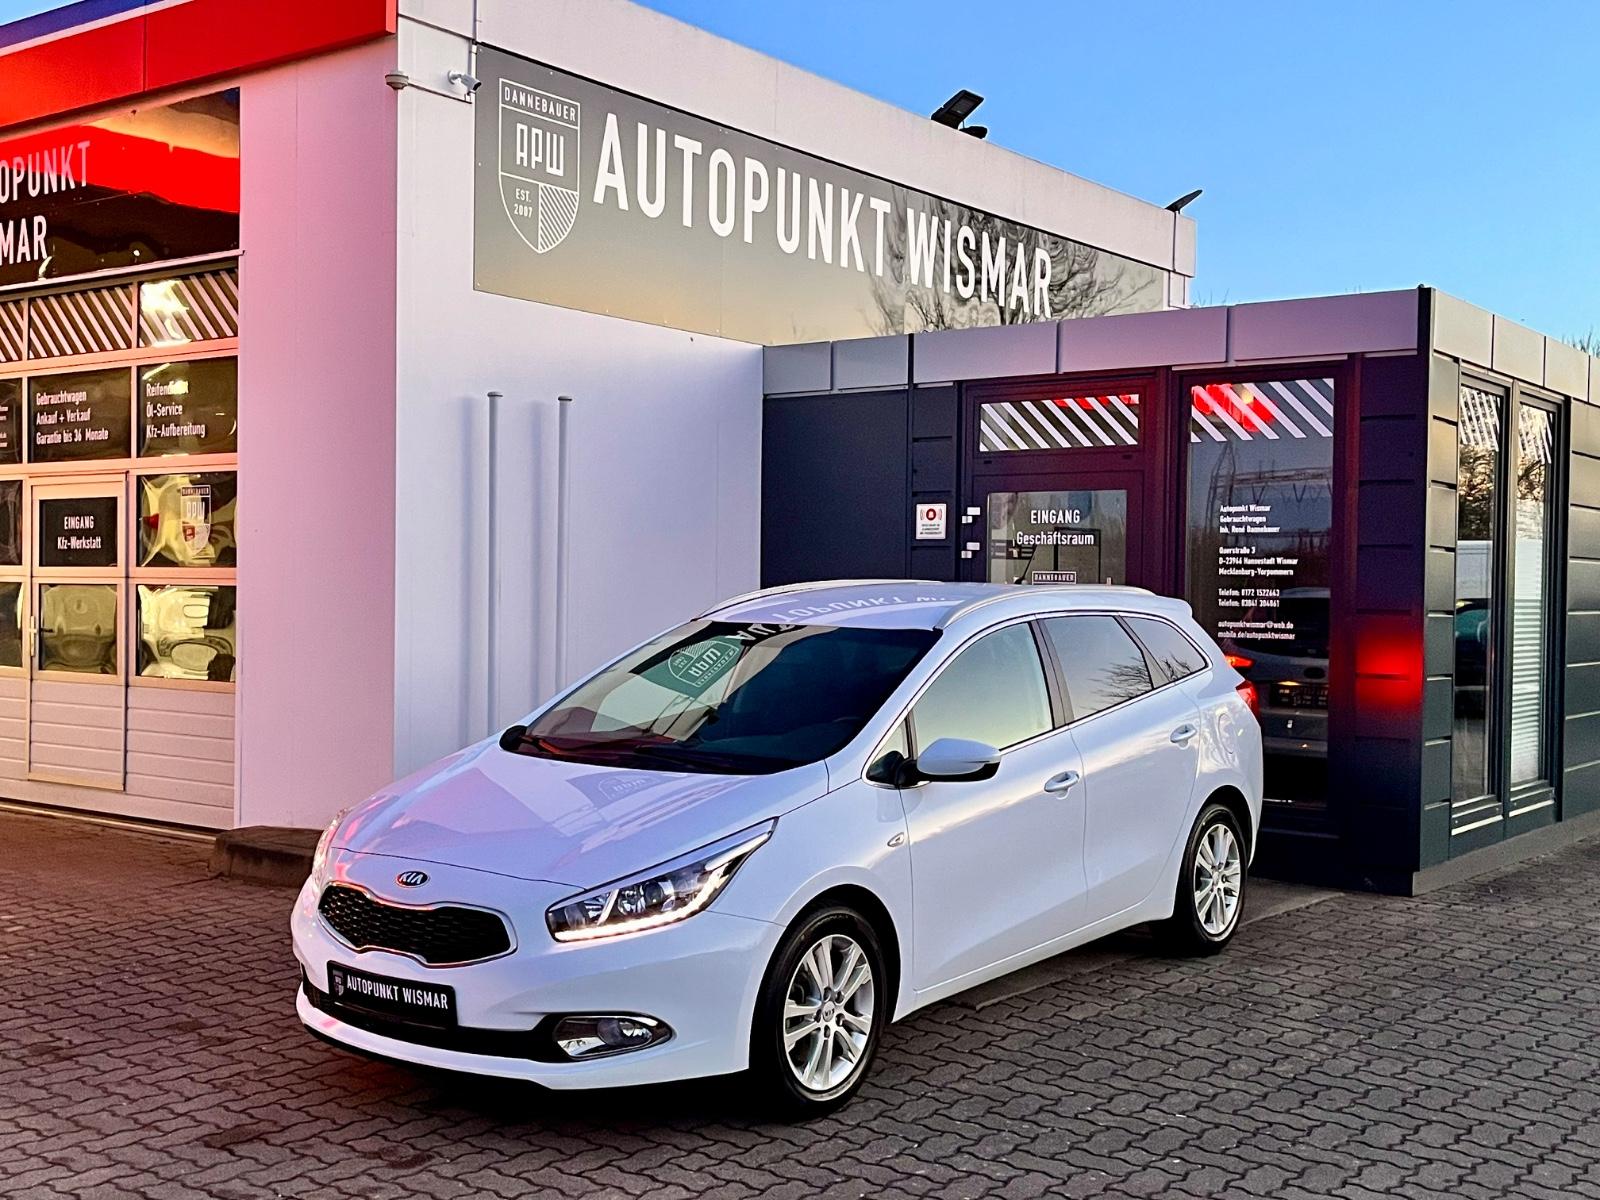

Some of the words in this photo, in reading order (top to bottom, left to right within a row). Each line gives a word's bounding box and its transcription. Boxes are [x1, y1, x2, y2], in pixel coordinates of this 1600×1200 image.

[504, 86, 576, 121] DANNEBAUER
[516, 123, 564, 176] APW
[515, 188, 531, 202] EST.
[514, 203, 533, 218] 2007
[593, 112, 891, 276] AUTOPUNKT
[906, 207, 1052, 318] WISMAR
[36, 390, 87, 406] Gebrauchtwagen
[36, 410, 58, 425] Ankauf
[66, 408, 91, 422] Verkauf
[146, 401, 183, 417] Öl-Service
[36, 430, 62, 445] Garantie
[63, 429, 72, 442] bis
[73, 428, 82, 442] 36
[85, 427, 109, 441] Monate
[146, 422, 206, 438] Kfz-Aufbereitung
[63, 515, 95, 530] EINGANG
[1030, 509, 1080, 524] EINGANG
[57, 535, 102, 550] Kfz-Werkstatt
[1016, 531, 1094, 545] Geschäftsraum
[399, 872, 424, 885] KIA
[346, 974, 398, 1001] AUTOPUNKT
[402, 987, 449, 1010] WISMAR
